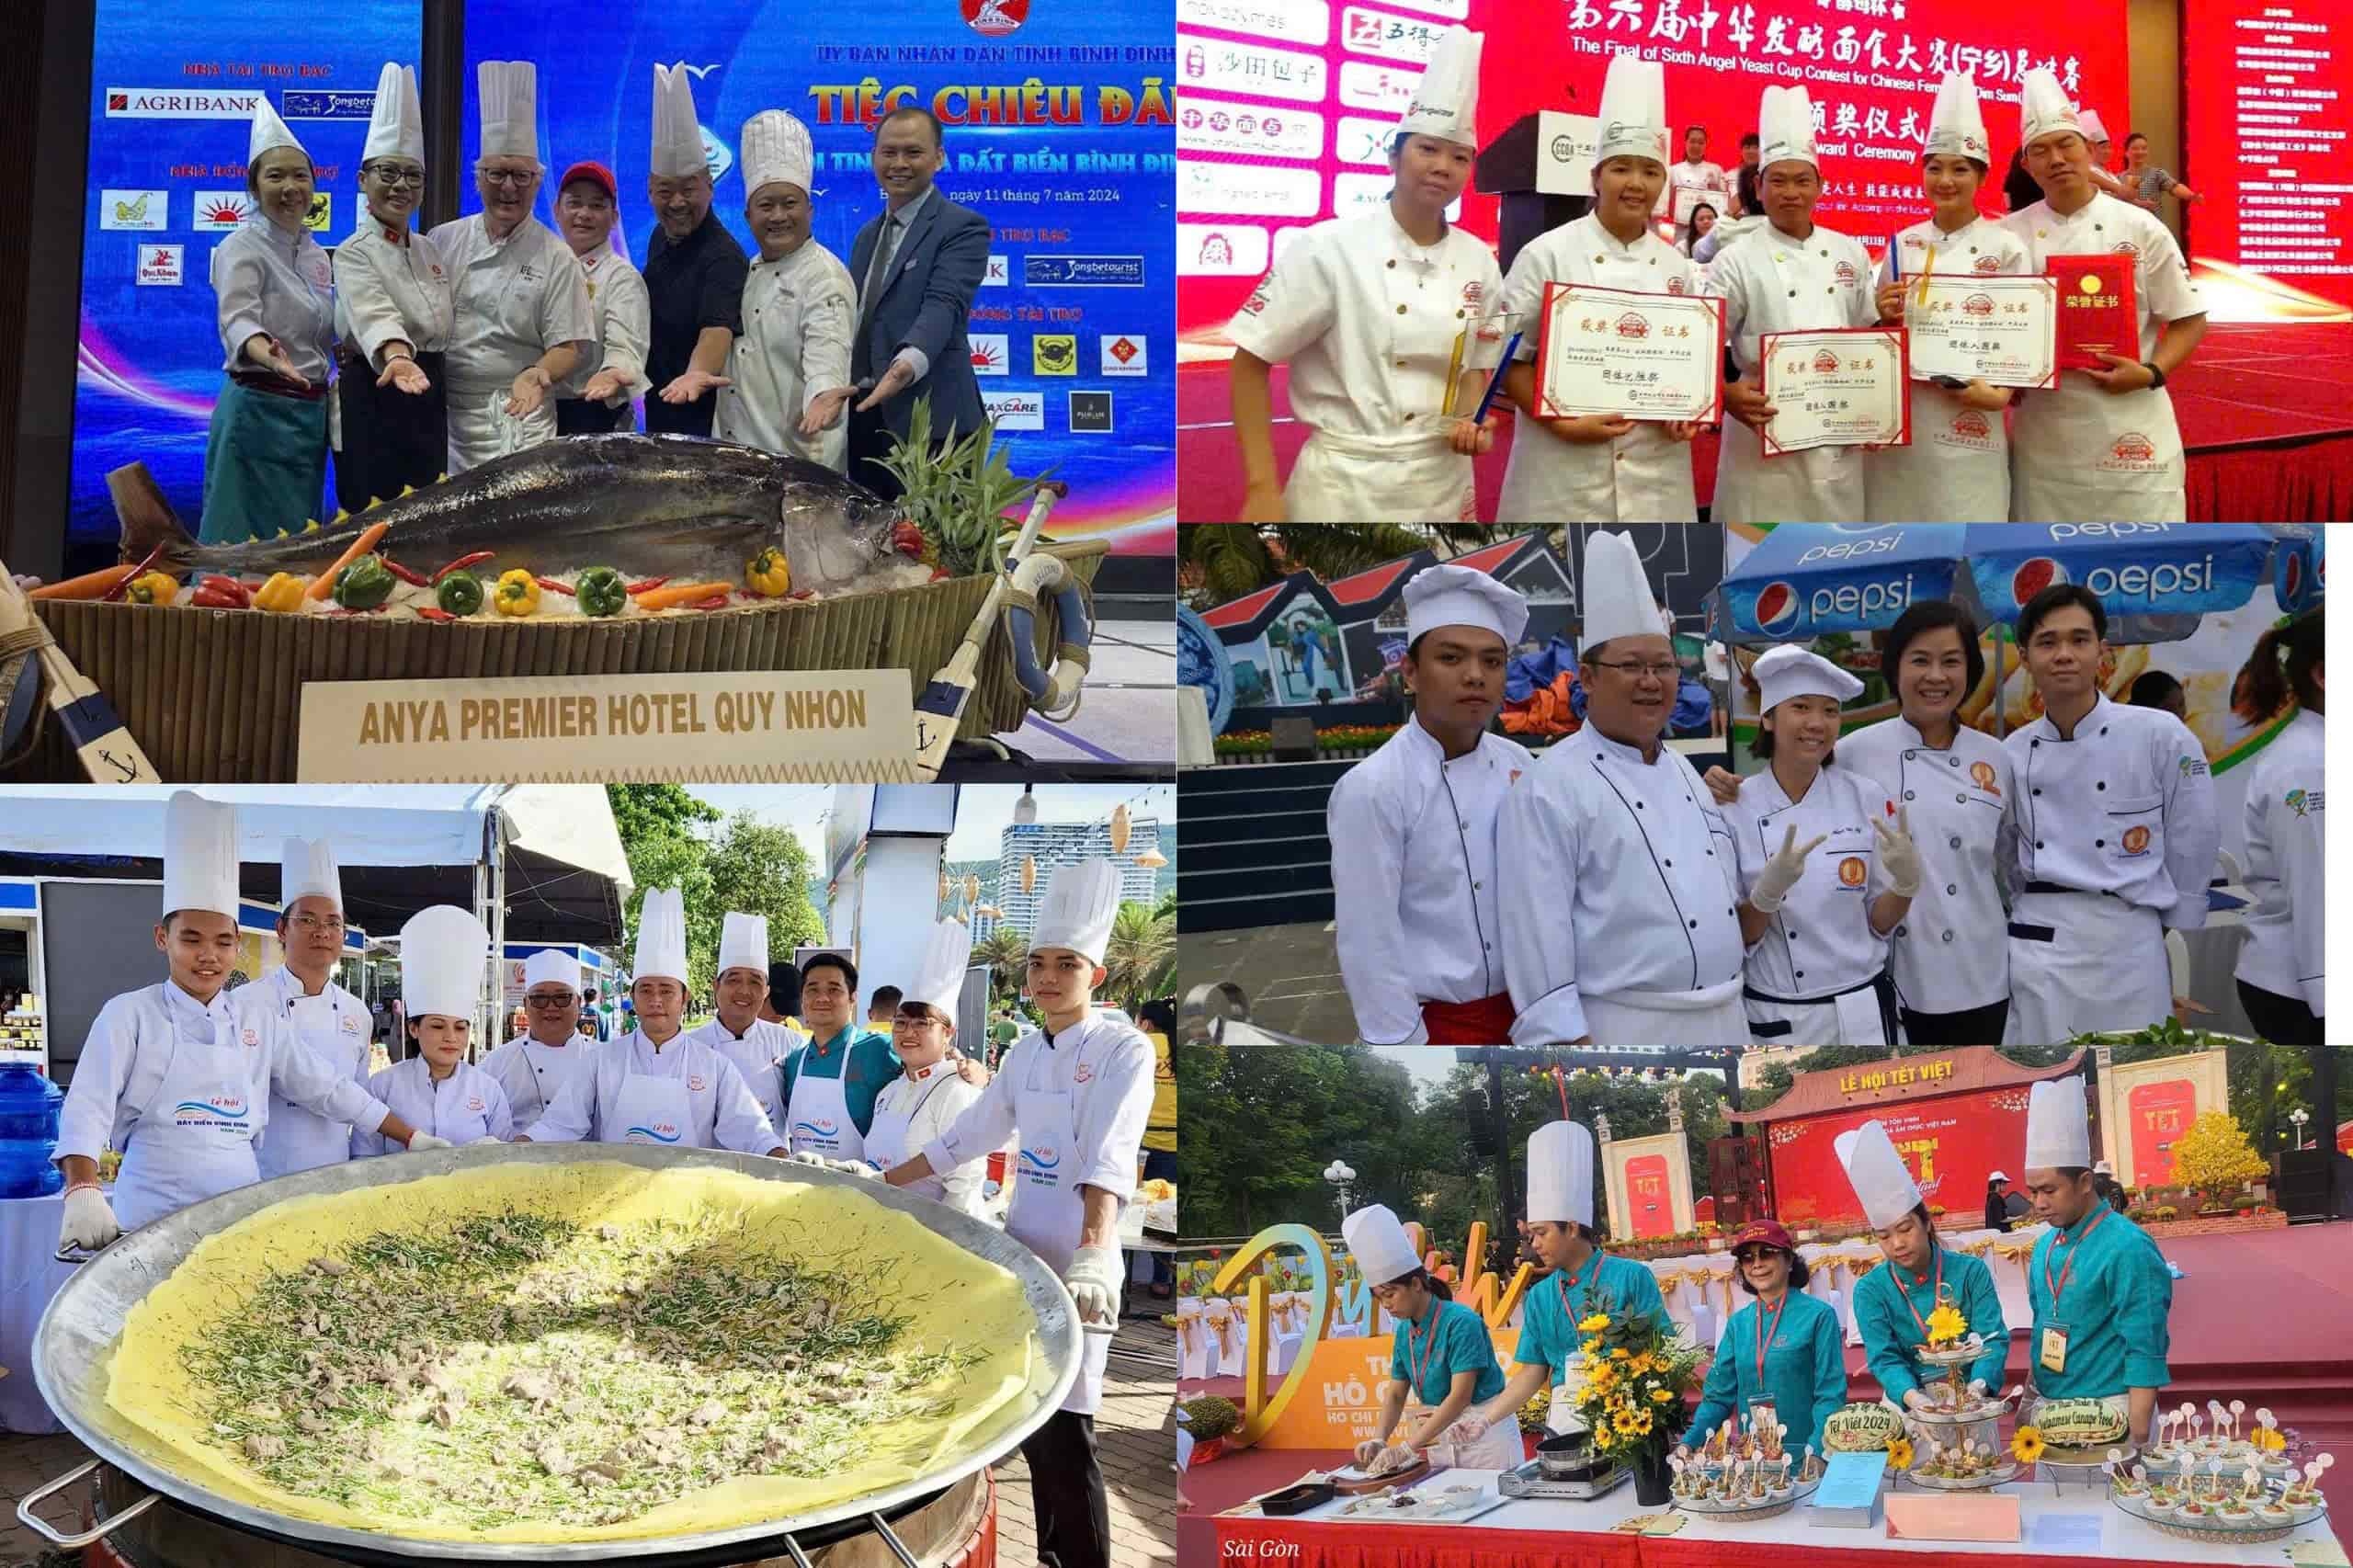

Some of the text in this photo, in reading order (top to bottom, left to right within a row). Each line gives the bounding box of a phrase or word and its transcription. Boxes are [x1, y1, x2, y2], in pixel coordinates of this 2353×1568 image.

[1573, 36, 1601, 54] The
[1604, 40, 1641, 60] Final
[1643, 46, 1659, 61] of
[1662, 47, 1696, 65] Sixth
[1699, 51, 1736, 73] Angel
[1739, 56, 1775, 74] Yeast
[1777, 61, 1803, 80] Cup
[1805, 64, 1850, 84] Contest
[1853, 71, 1870, 85] for
[1870, 73, 1915, 91] Chinese
[135, 95, 259, 111] AGRIBANK
[809, 76, 917, 132] TIỆC
[933, 77, 1086, 127] CHIÊU
[830, 151, 873, 172] TIN
[1853, 142, 1916, 165] Ceremony
[949, 187, 1120, 203] ngày 11 tháng 7 năm 2024
[2065, 295, 2119, 309] 荣誉证书
[1798, 530, 1904, 566] pepsi
[1809, 573, 1913, 624] pepsi
[359, 687, 867, 745] ANYA PREMIER HOTEL QUY NHON
[1327, 1411, 1372, 1424] HO CHI
[1863, 1415, 1891, 1430] 2024
